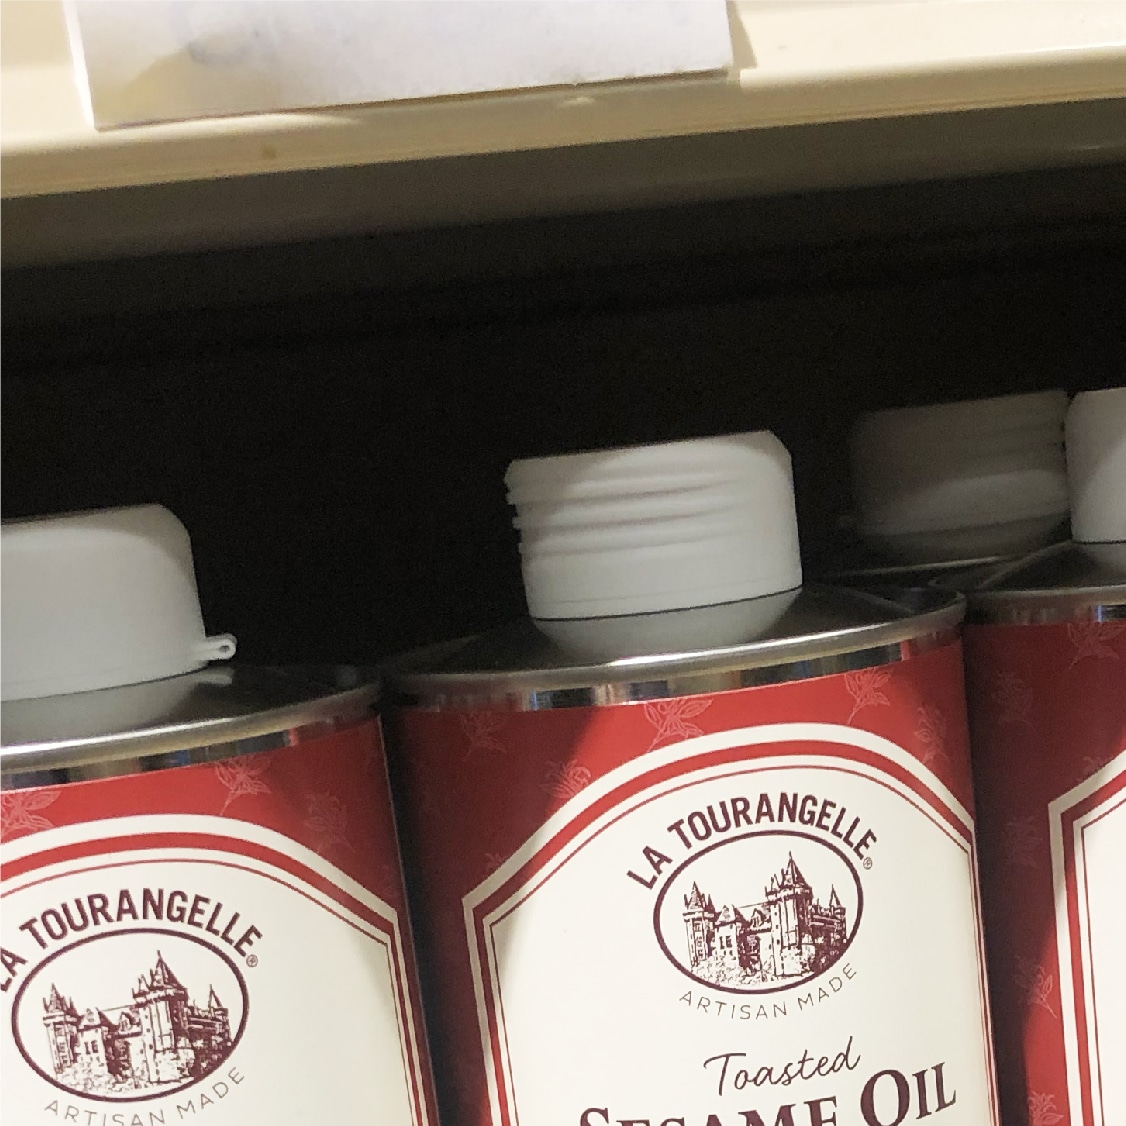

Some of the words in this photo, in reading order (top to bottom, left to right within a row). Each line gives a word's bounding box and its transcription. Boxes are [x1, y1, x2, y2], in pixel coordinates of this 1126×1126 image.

[626, 844, 673, 890] LA
[667, 791, 878, 862] TOURANGELLE
[19, 888, 263, 957] TOURANGELLE
[678, 990, 788, 1021] ARTISAN
[796, 961, 858, 1011] MADE
[176, 1065, 245, 1120] MADE
[703, 1035, 862, 1097] Toasted
